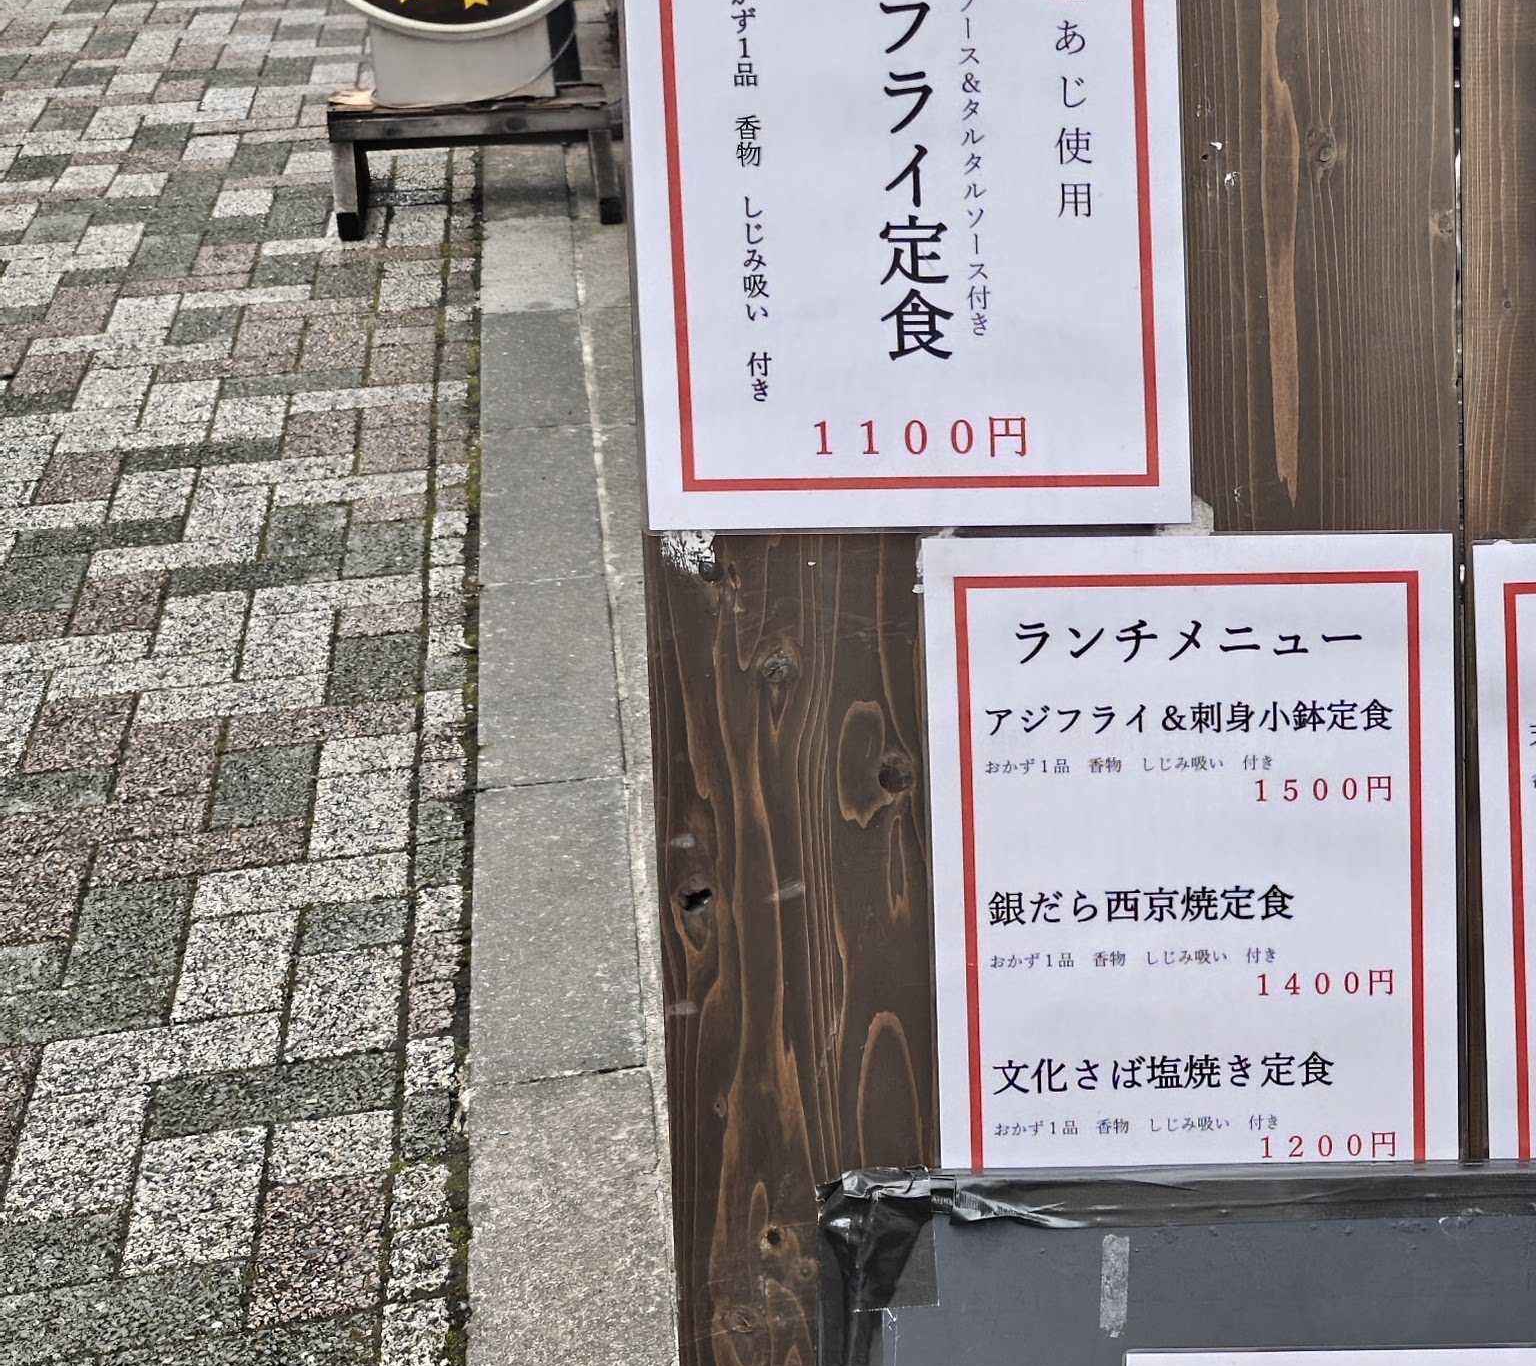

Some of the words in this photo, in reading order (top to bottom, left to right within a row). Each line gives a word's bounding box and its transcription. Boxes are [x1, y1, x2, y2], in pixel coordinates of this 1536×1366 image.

[734, 115, 762, 168] 香物
[742, 195, 769, 322] しじみ吸い
[746, 350, 772, 403] 付き
[813, 415, 1029, 460] 1100円
[1013, 619, 1366, 665] ランチメニュー
[984, 697, 1395, 737] アジフライ&刺身小鉢定食
[985, 757, 1071, 776] おかず1品
[1089, 756, 1122, 774] 香物
[1141, 754, 1225, 773] しじみ吸い
[1242, 753, 1274, 772] 付き
[1254, 774, 1394, 805] 1500円
[988, 884, 1296, 926] 銀だら西京焼定食
[989, 951, 1075, 970] おかず1品
[1092, 950, 1127, 968] 香物
[1144, 948, 1228, 967] しじみ吸い
[1245, 946, 1278, 965] 付き
[1256, 969, 1396, 998] 1400円
[992, 1050, 1336, 1096] 文化さば塩焼き定食
[994, 1119, 1080, 1137] おかず1品
[1096, 1117, 1130, 1135] 香物
[1148, 1115, 1231, 1133] しじみ吸い
[1248, 1113, 1279, 1132] 付き
[1260, 1131, 1397, 1161] 1200円
